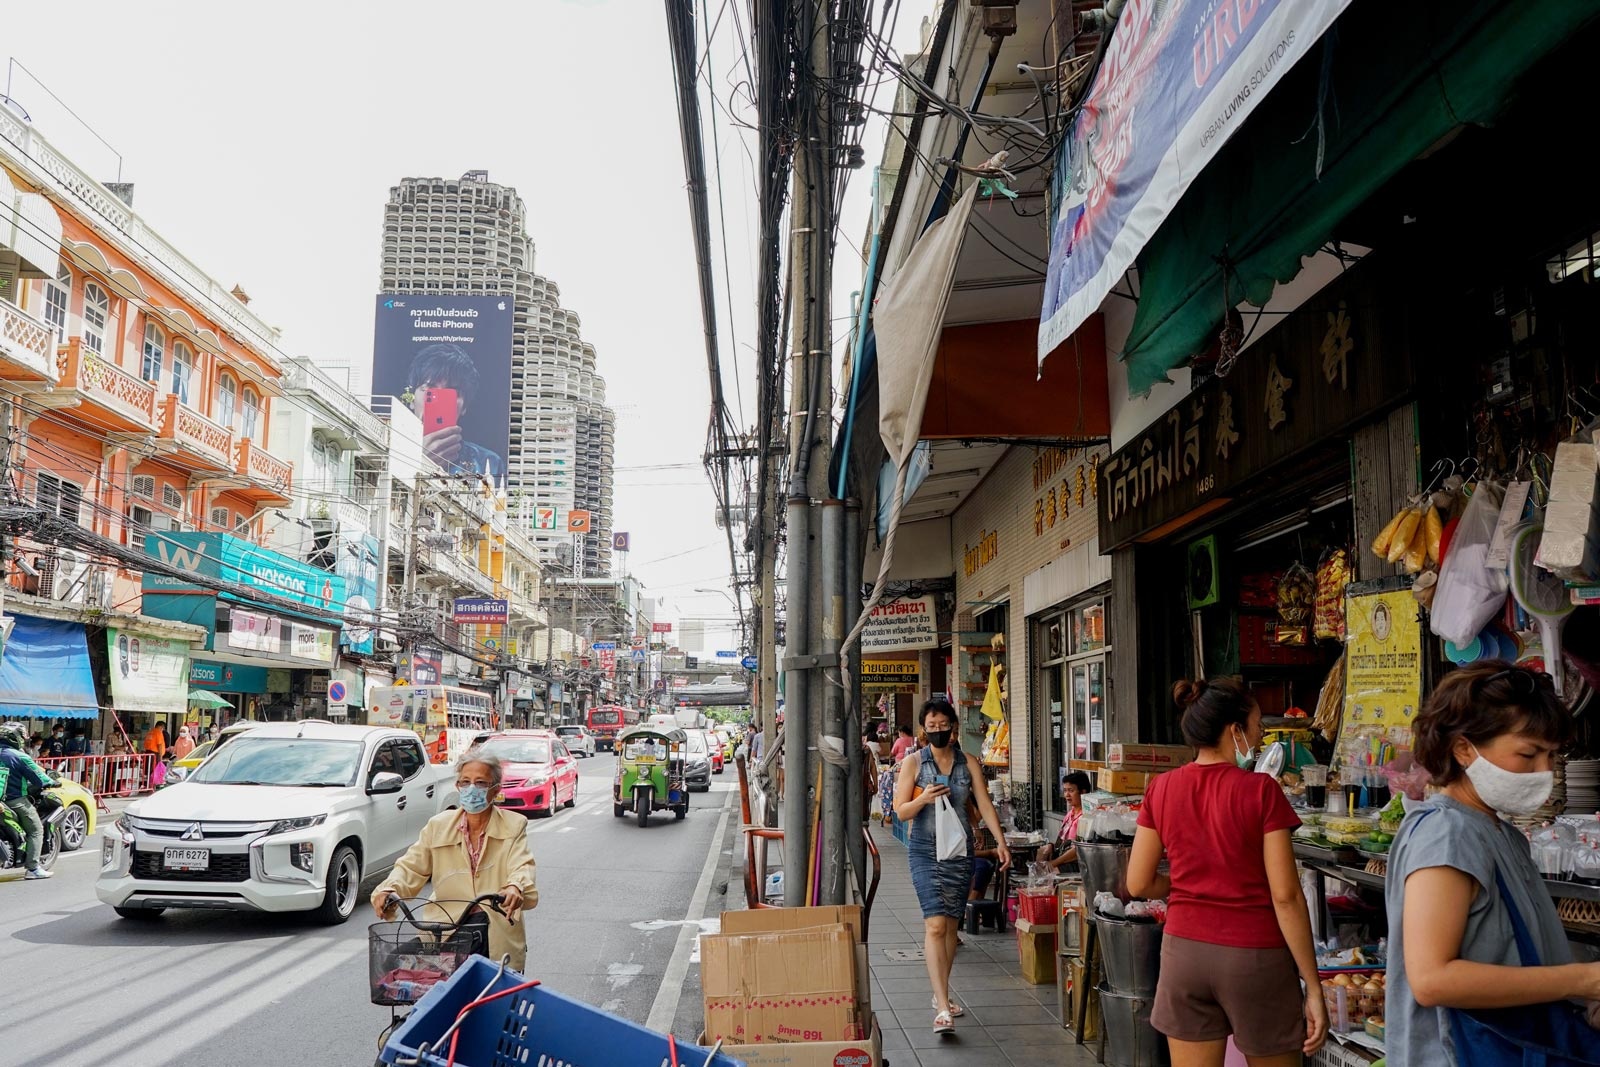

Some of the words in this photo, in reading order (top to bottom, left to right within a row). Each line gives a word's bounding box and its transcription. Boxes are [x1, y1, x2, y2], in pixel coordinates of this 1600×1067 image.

[1193, 0, 1265, 89] URB
[1200, 114, 1226, 148] URBAN
[1224, 85, 1251, 121] LIVING
[1250, 29, 1296, 91] SOLUTIONS
[410, 307, 479, 318] ความเป็นส่วนตัว
[442, 320, 474, 329] iPhone
[411, 335, 474, 343] apple.com/th/privacy
[1196, 474, 1215, 497] 1486
[252, 564, 306, 598] watsons
[457, 601, 505, 612] สกลคลินิก
[298, 632, 315, 644] more
[186, 850, 208, 860] 6272
[803, 1030, 823, 1041] 168
